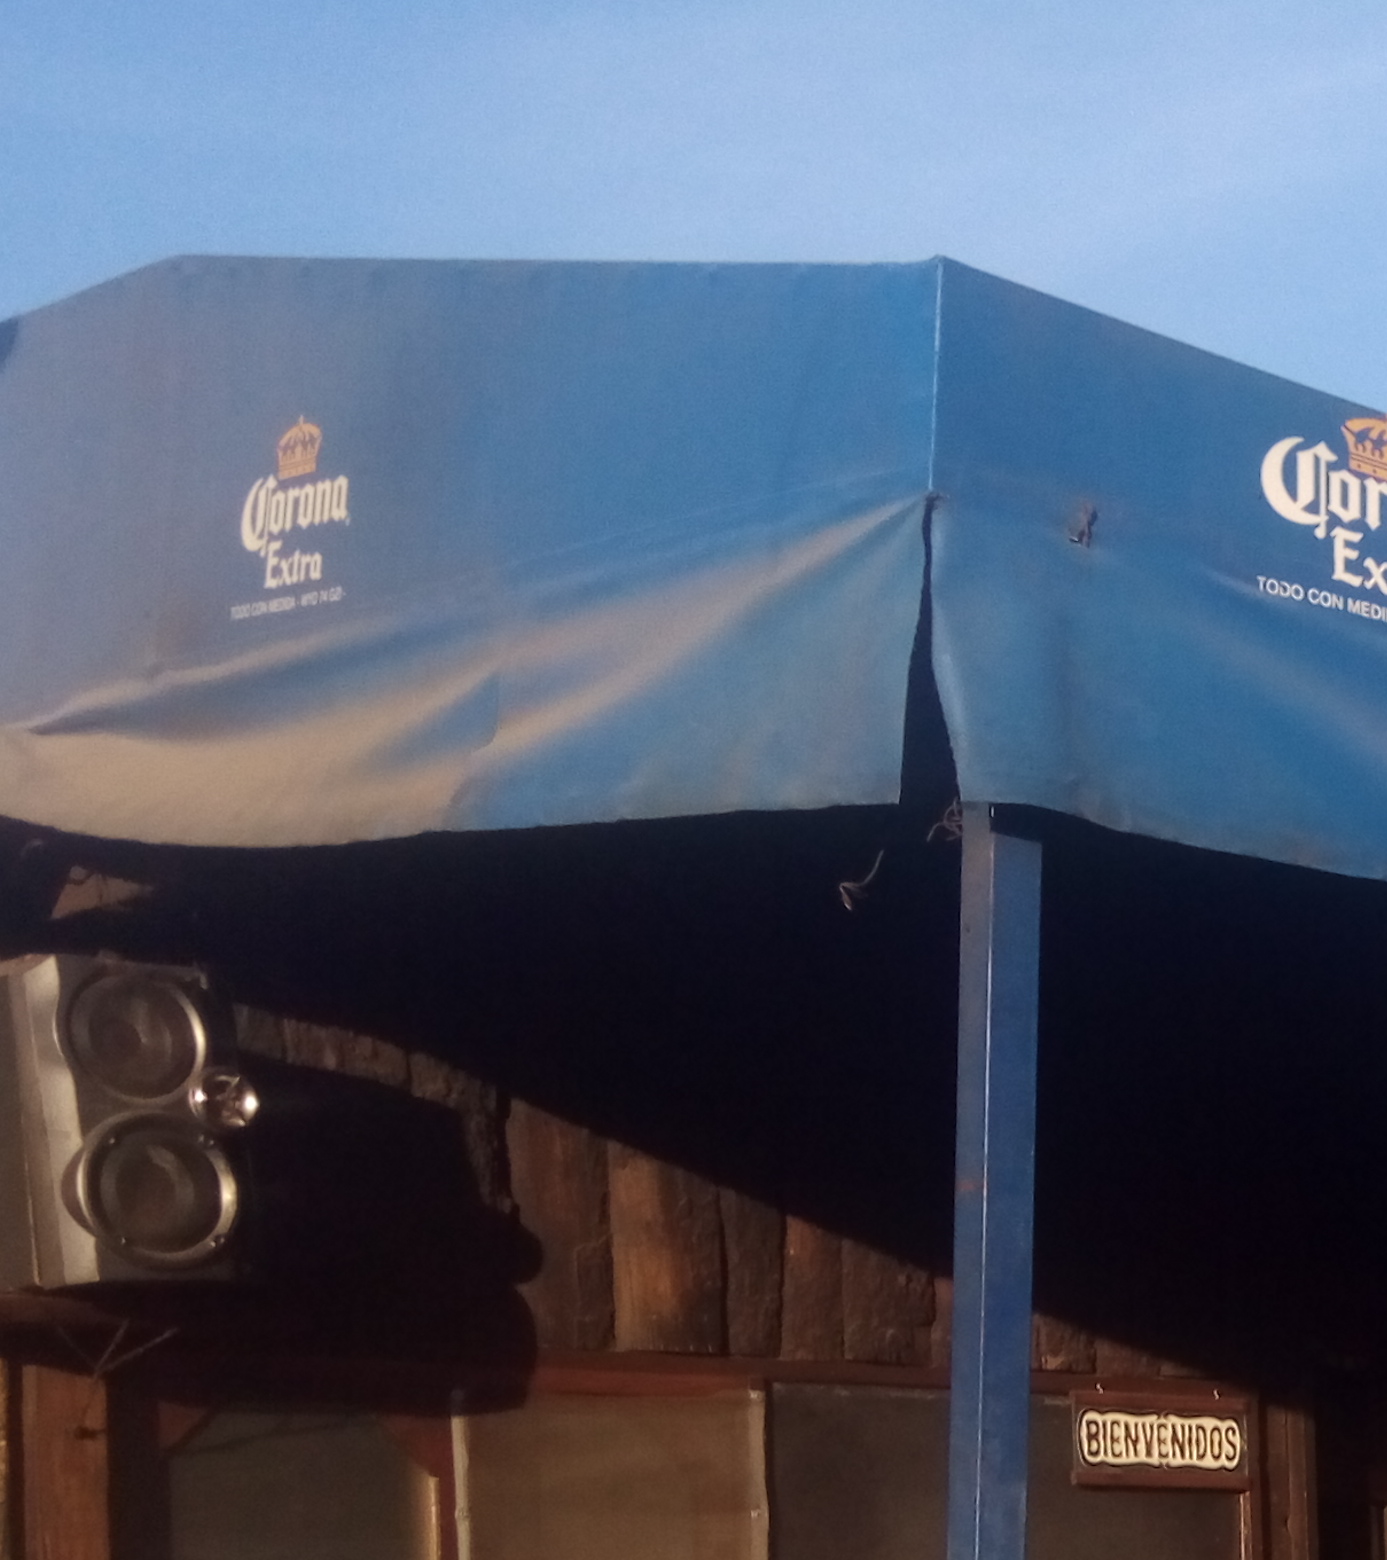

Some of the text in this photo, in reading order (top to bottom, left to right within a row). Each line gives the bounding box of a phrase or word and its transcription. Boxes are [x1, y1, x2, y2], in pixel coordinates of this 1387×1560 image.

[241, 474, 349, 557] Corona
[264, 539, 322, 589] Extra
[1307, 587, 1344, 611] CON
[1086, 1418, 1237, 1462] BIENVENIDOS
